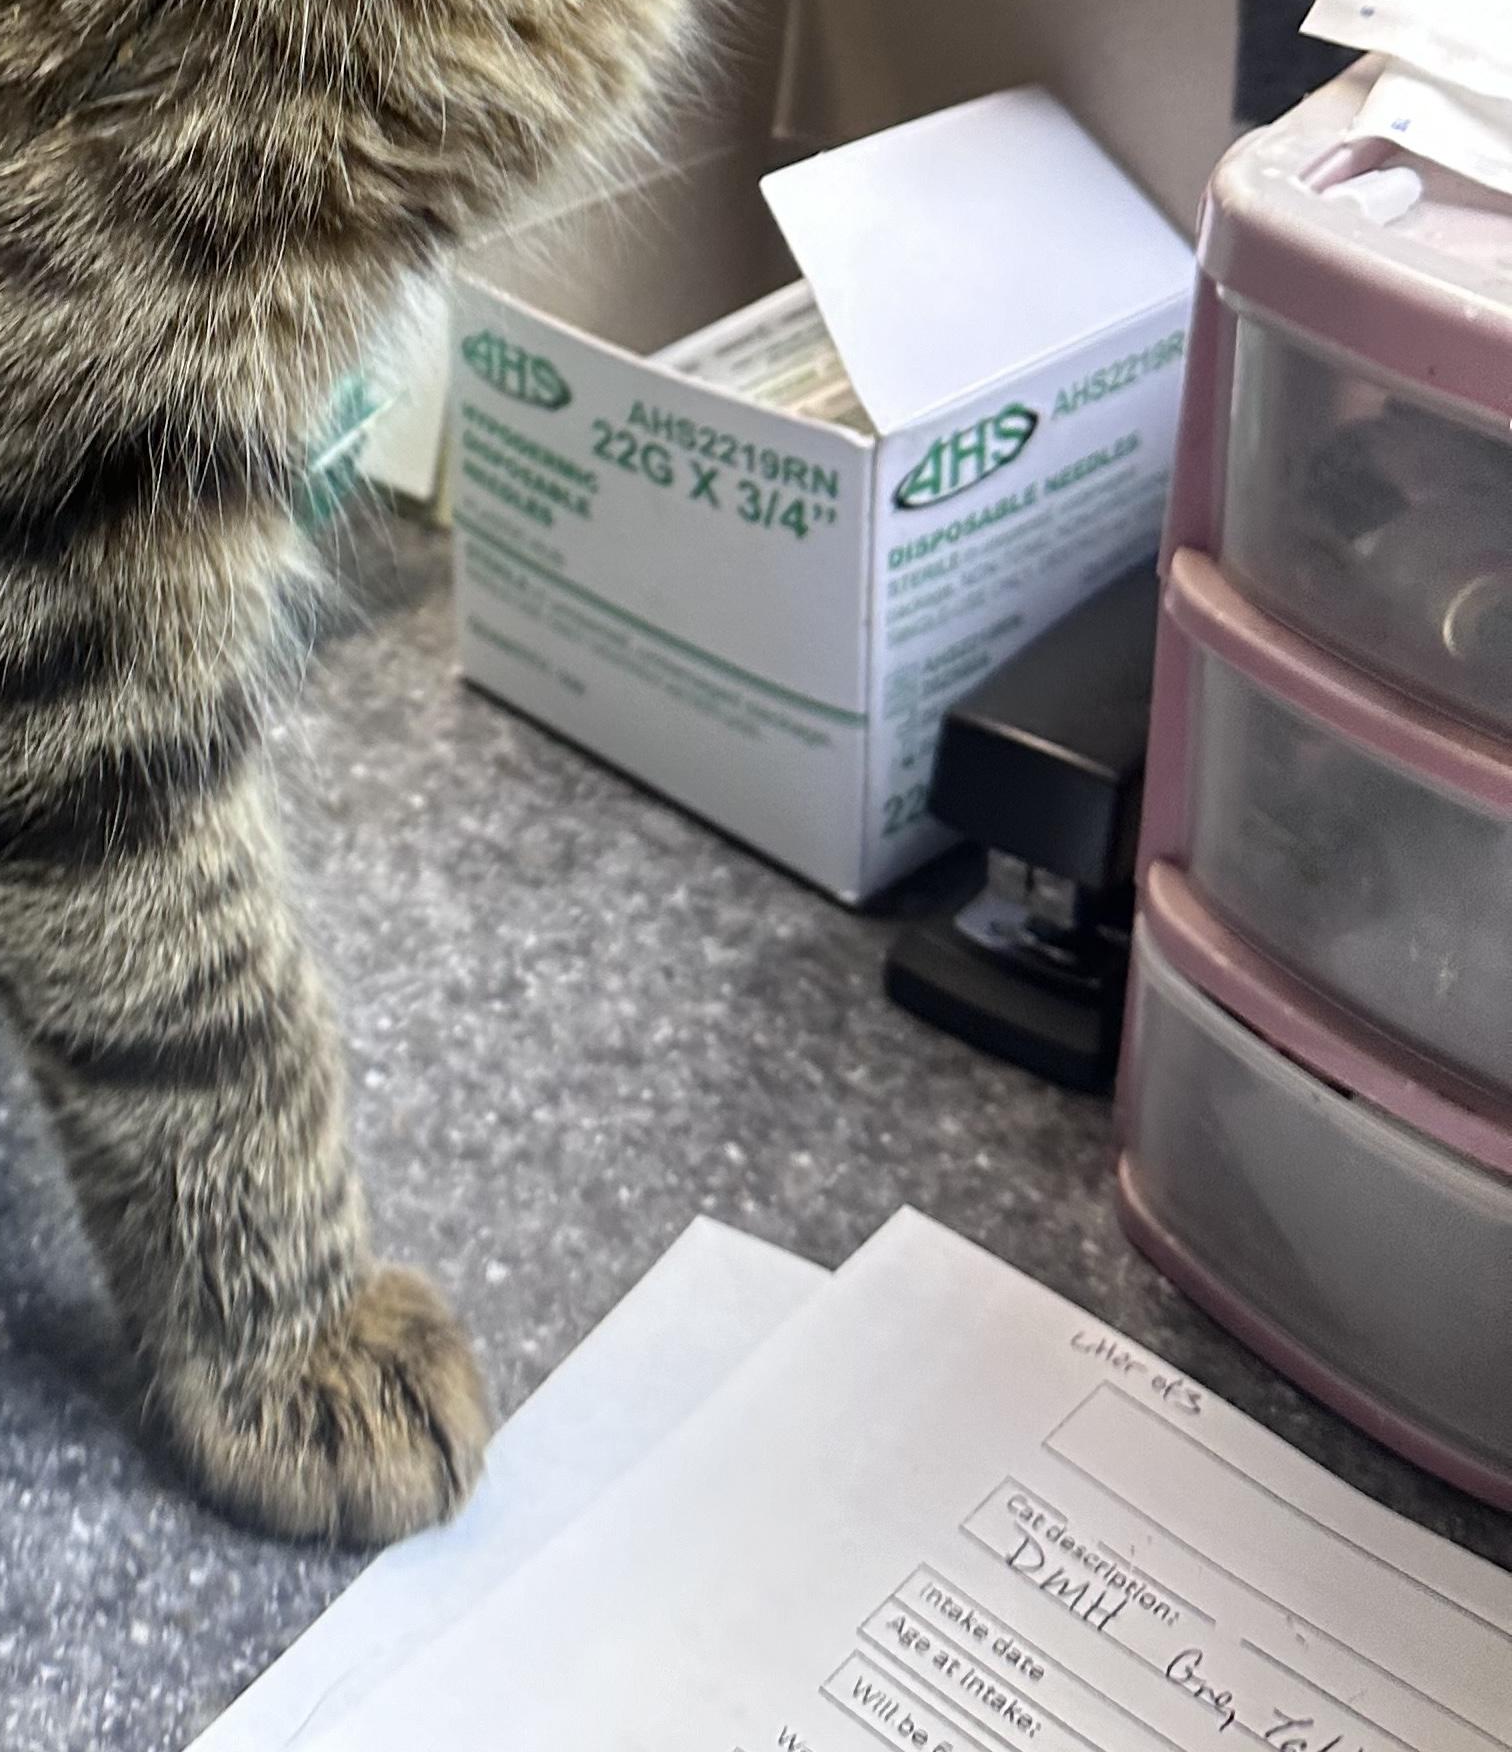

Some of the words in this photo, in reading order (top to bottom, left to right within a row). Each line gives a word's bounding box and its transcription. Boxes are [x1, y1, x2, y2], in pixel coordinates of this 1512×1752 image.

[592, 418, 675, 488] 22G
[627, 400, 840, 499] AHS2219RN
[899, 402, 1034, 500] AHS
[887, 484, 1037, 571] DISPOSABLE
[1044, 430, 1140, 493] NEEDLES
[1005, 1520, 1128, 1632] DMH
[1007, 1494, 1047, 1531] Cat
[1045, 1524, 1180, 1627] description:
[886, 1615, 931, 1654] Age
[931, 1650, 961, 1678] at
[991, 1637, 1045, 1682] date
[897, 1713, 929, 1747] be
